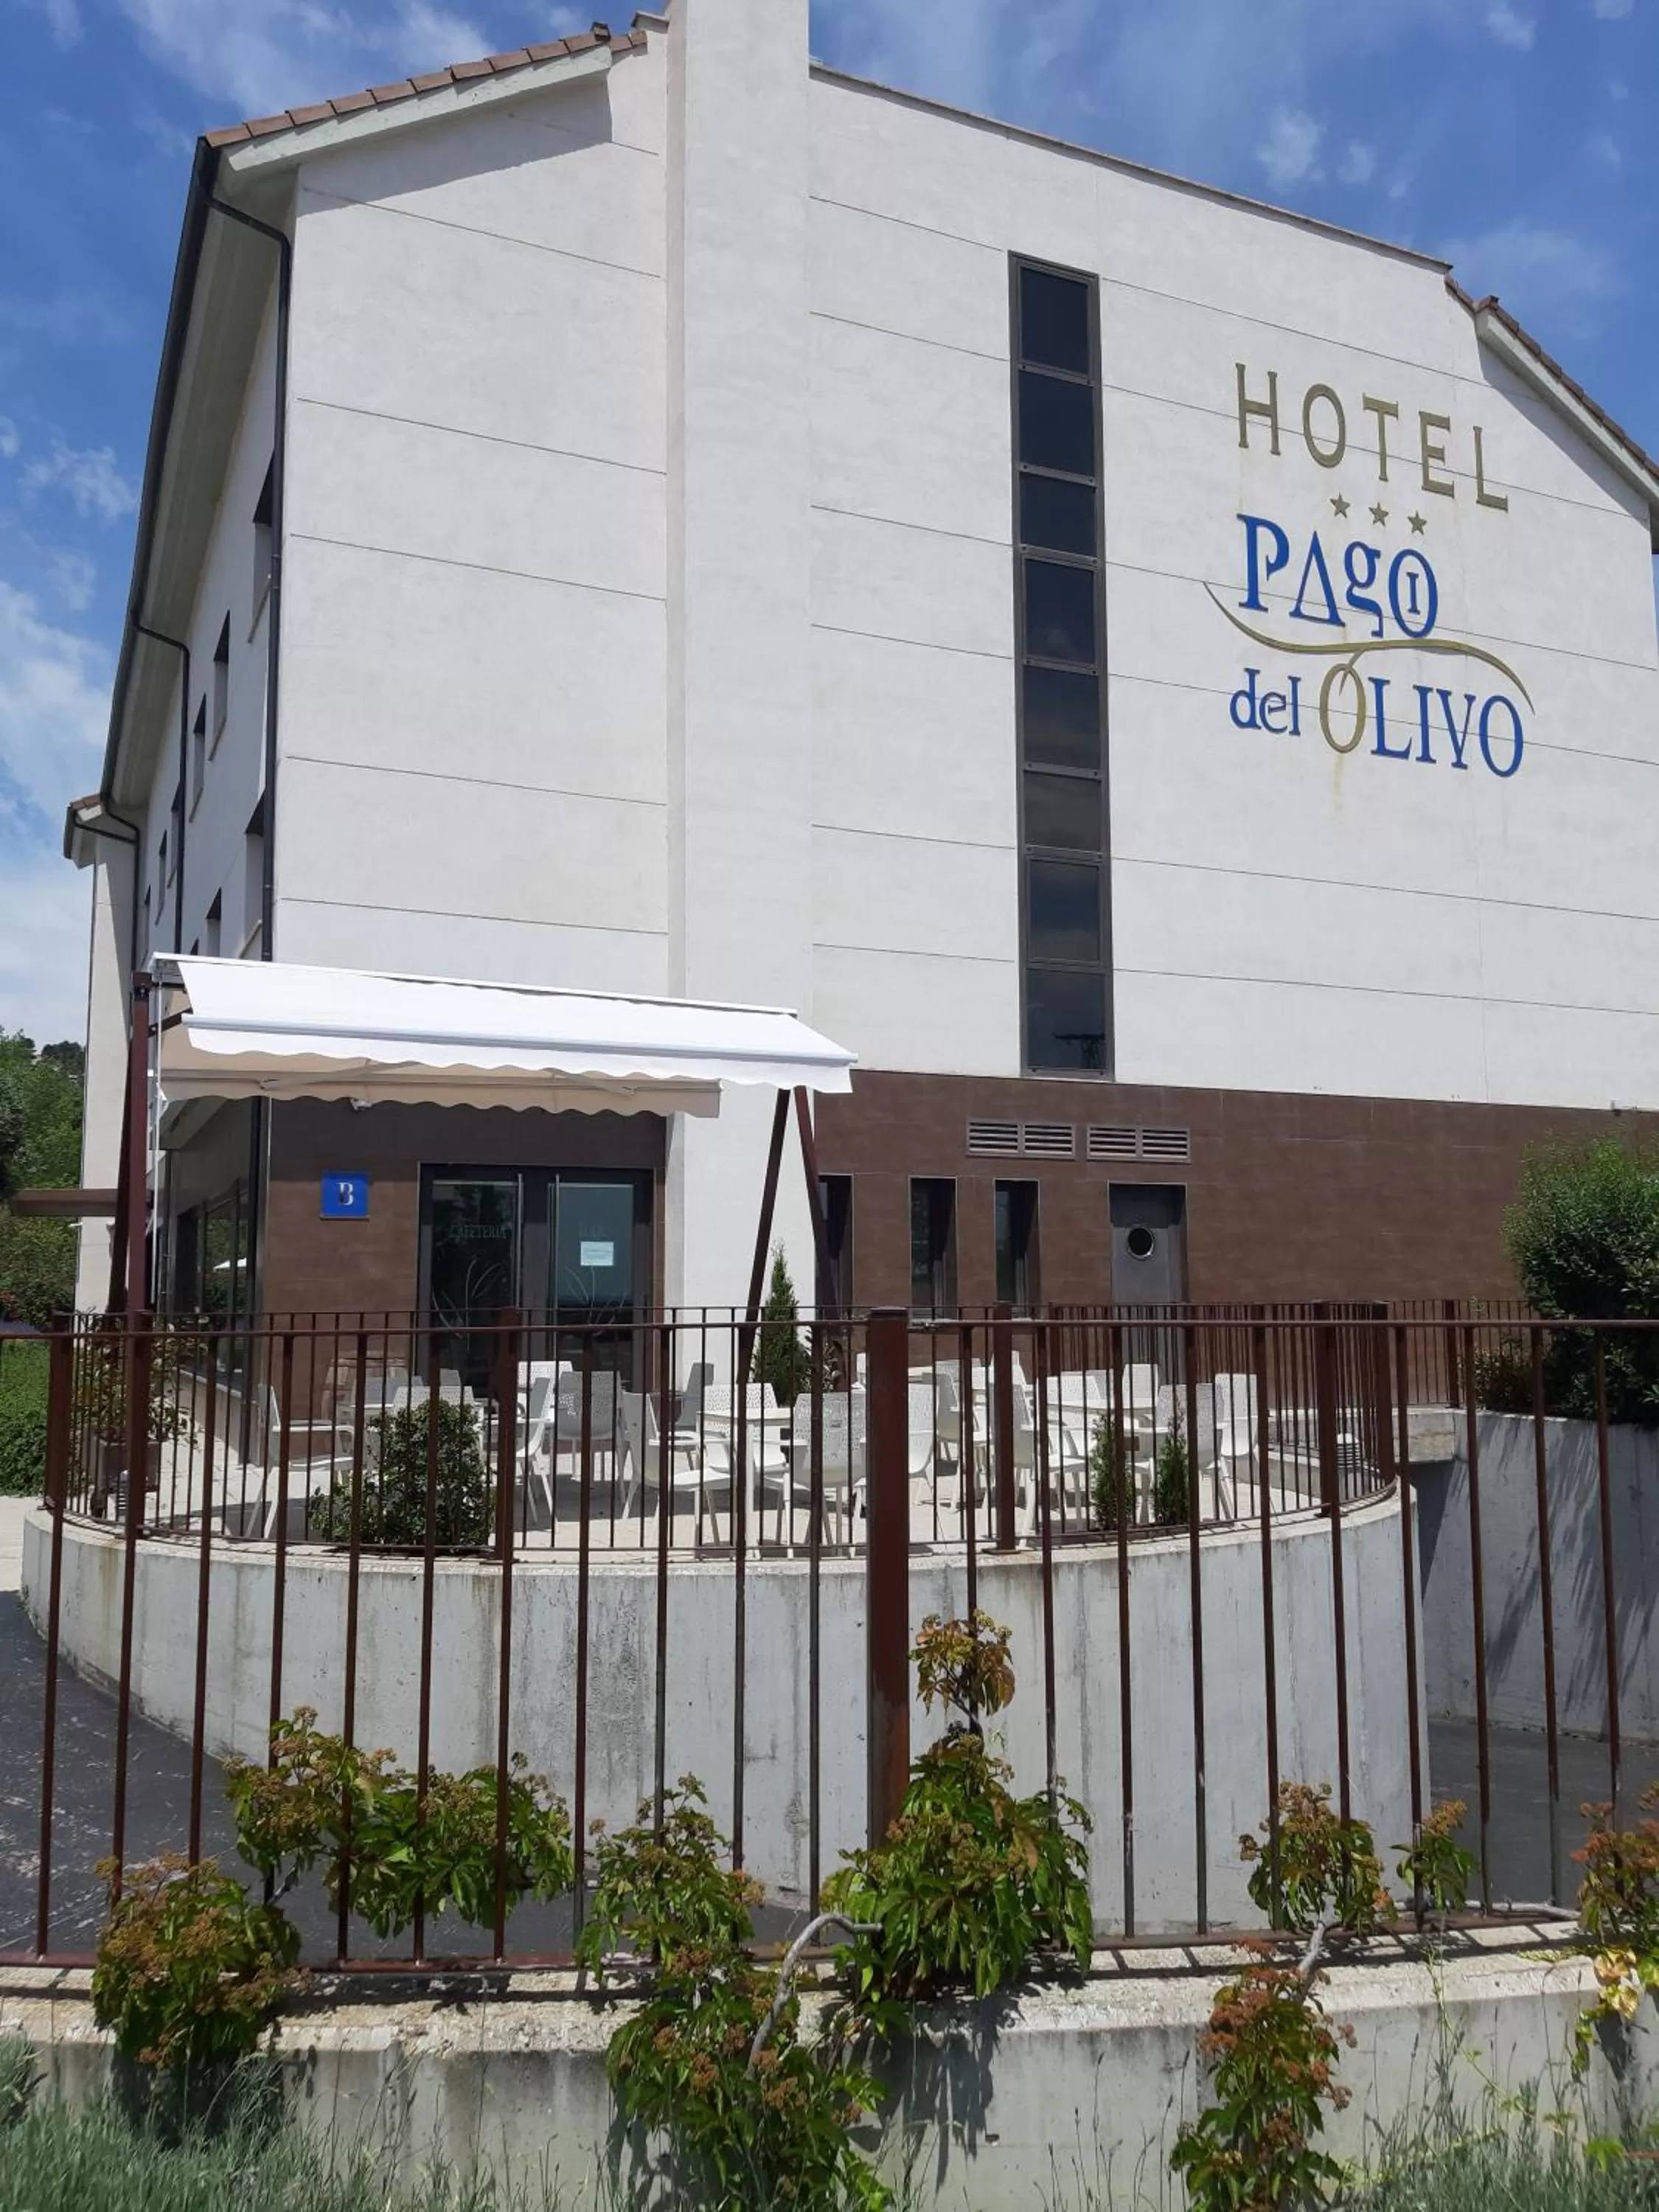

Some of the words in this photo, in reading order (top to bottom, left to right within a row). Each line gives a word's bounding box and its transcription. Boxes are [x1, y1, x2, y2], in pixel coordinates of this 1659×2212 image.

[1235, 362, 1509, 512] HOTEL
[1230, 667, 1301, 736] del
[1319, 663, 1523, 778] OLIVO
